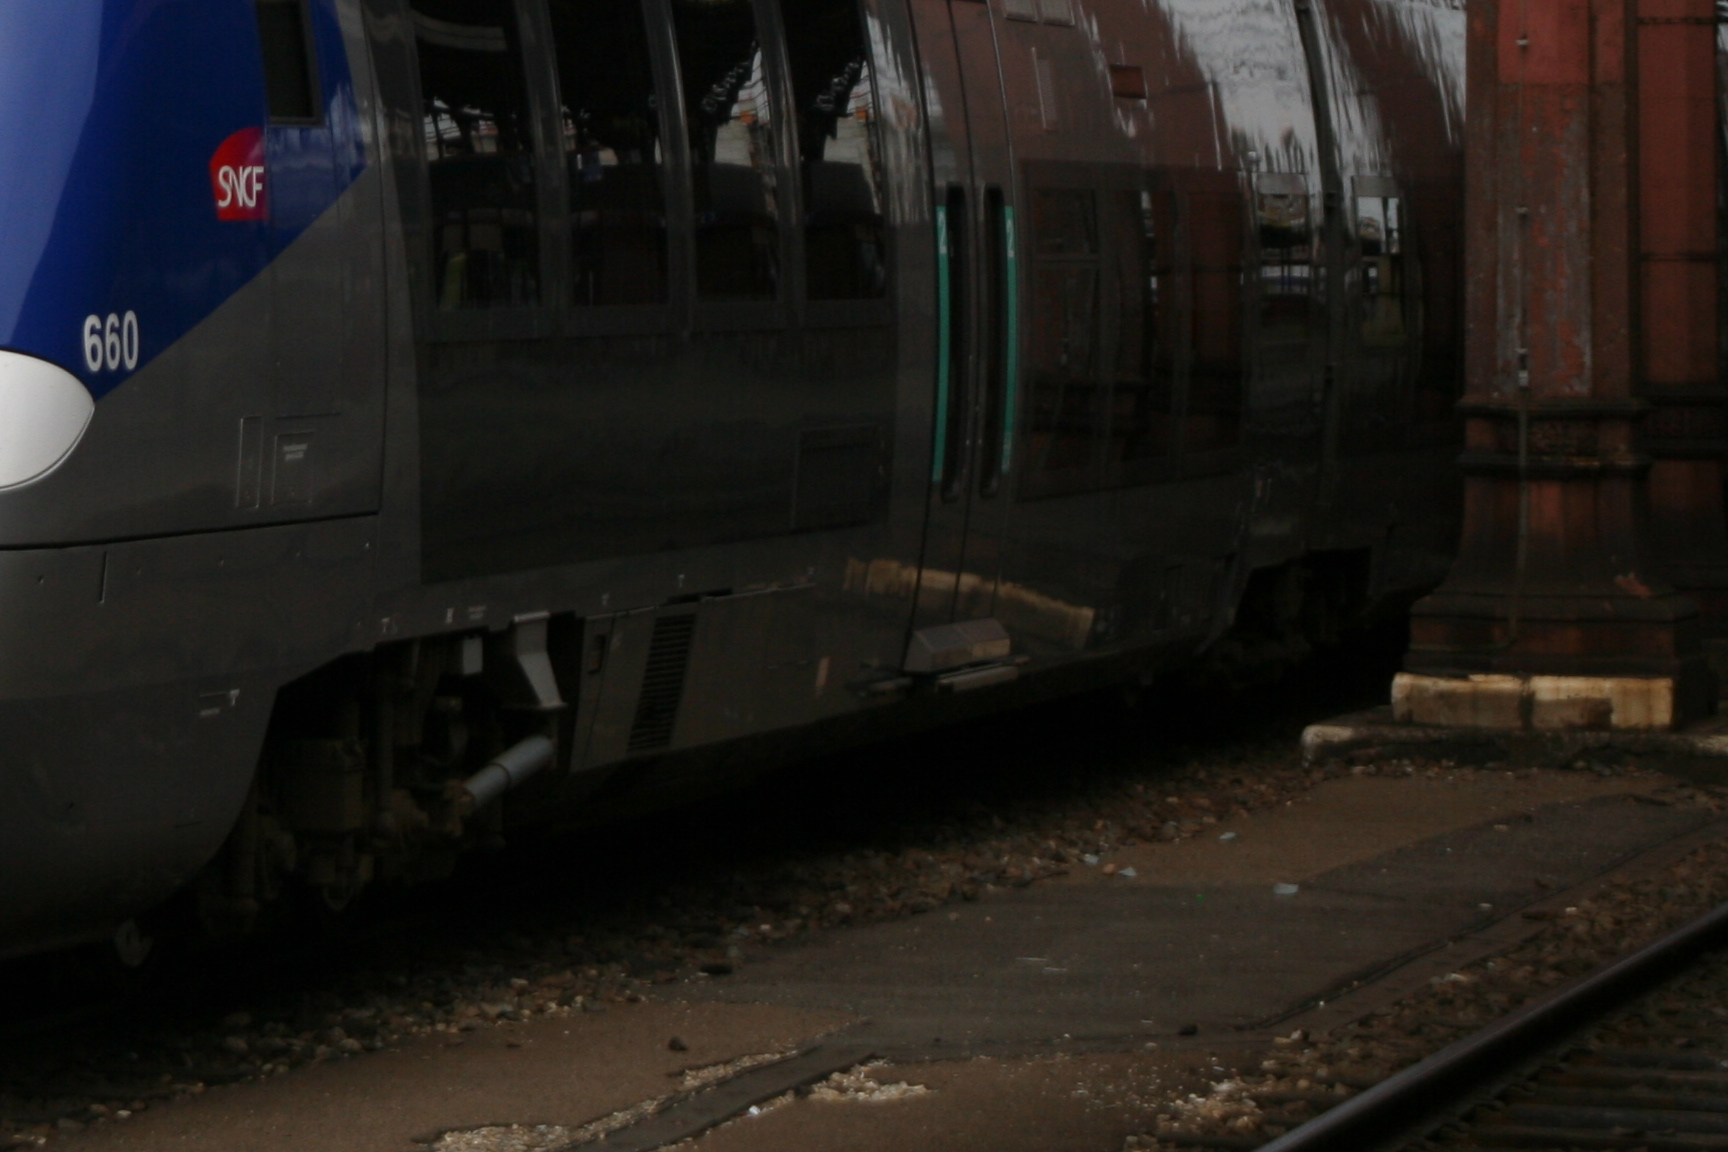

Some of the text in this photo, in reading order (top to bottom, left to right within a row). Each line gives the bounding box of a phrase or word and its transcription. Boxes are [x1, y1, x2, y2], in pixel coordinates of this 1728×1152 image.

[218, 165, 264, 207] SNCF
[936, 211, 948, 254] 2
[83, 310, 139, 372] 660
